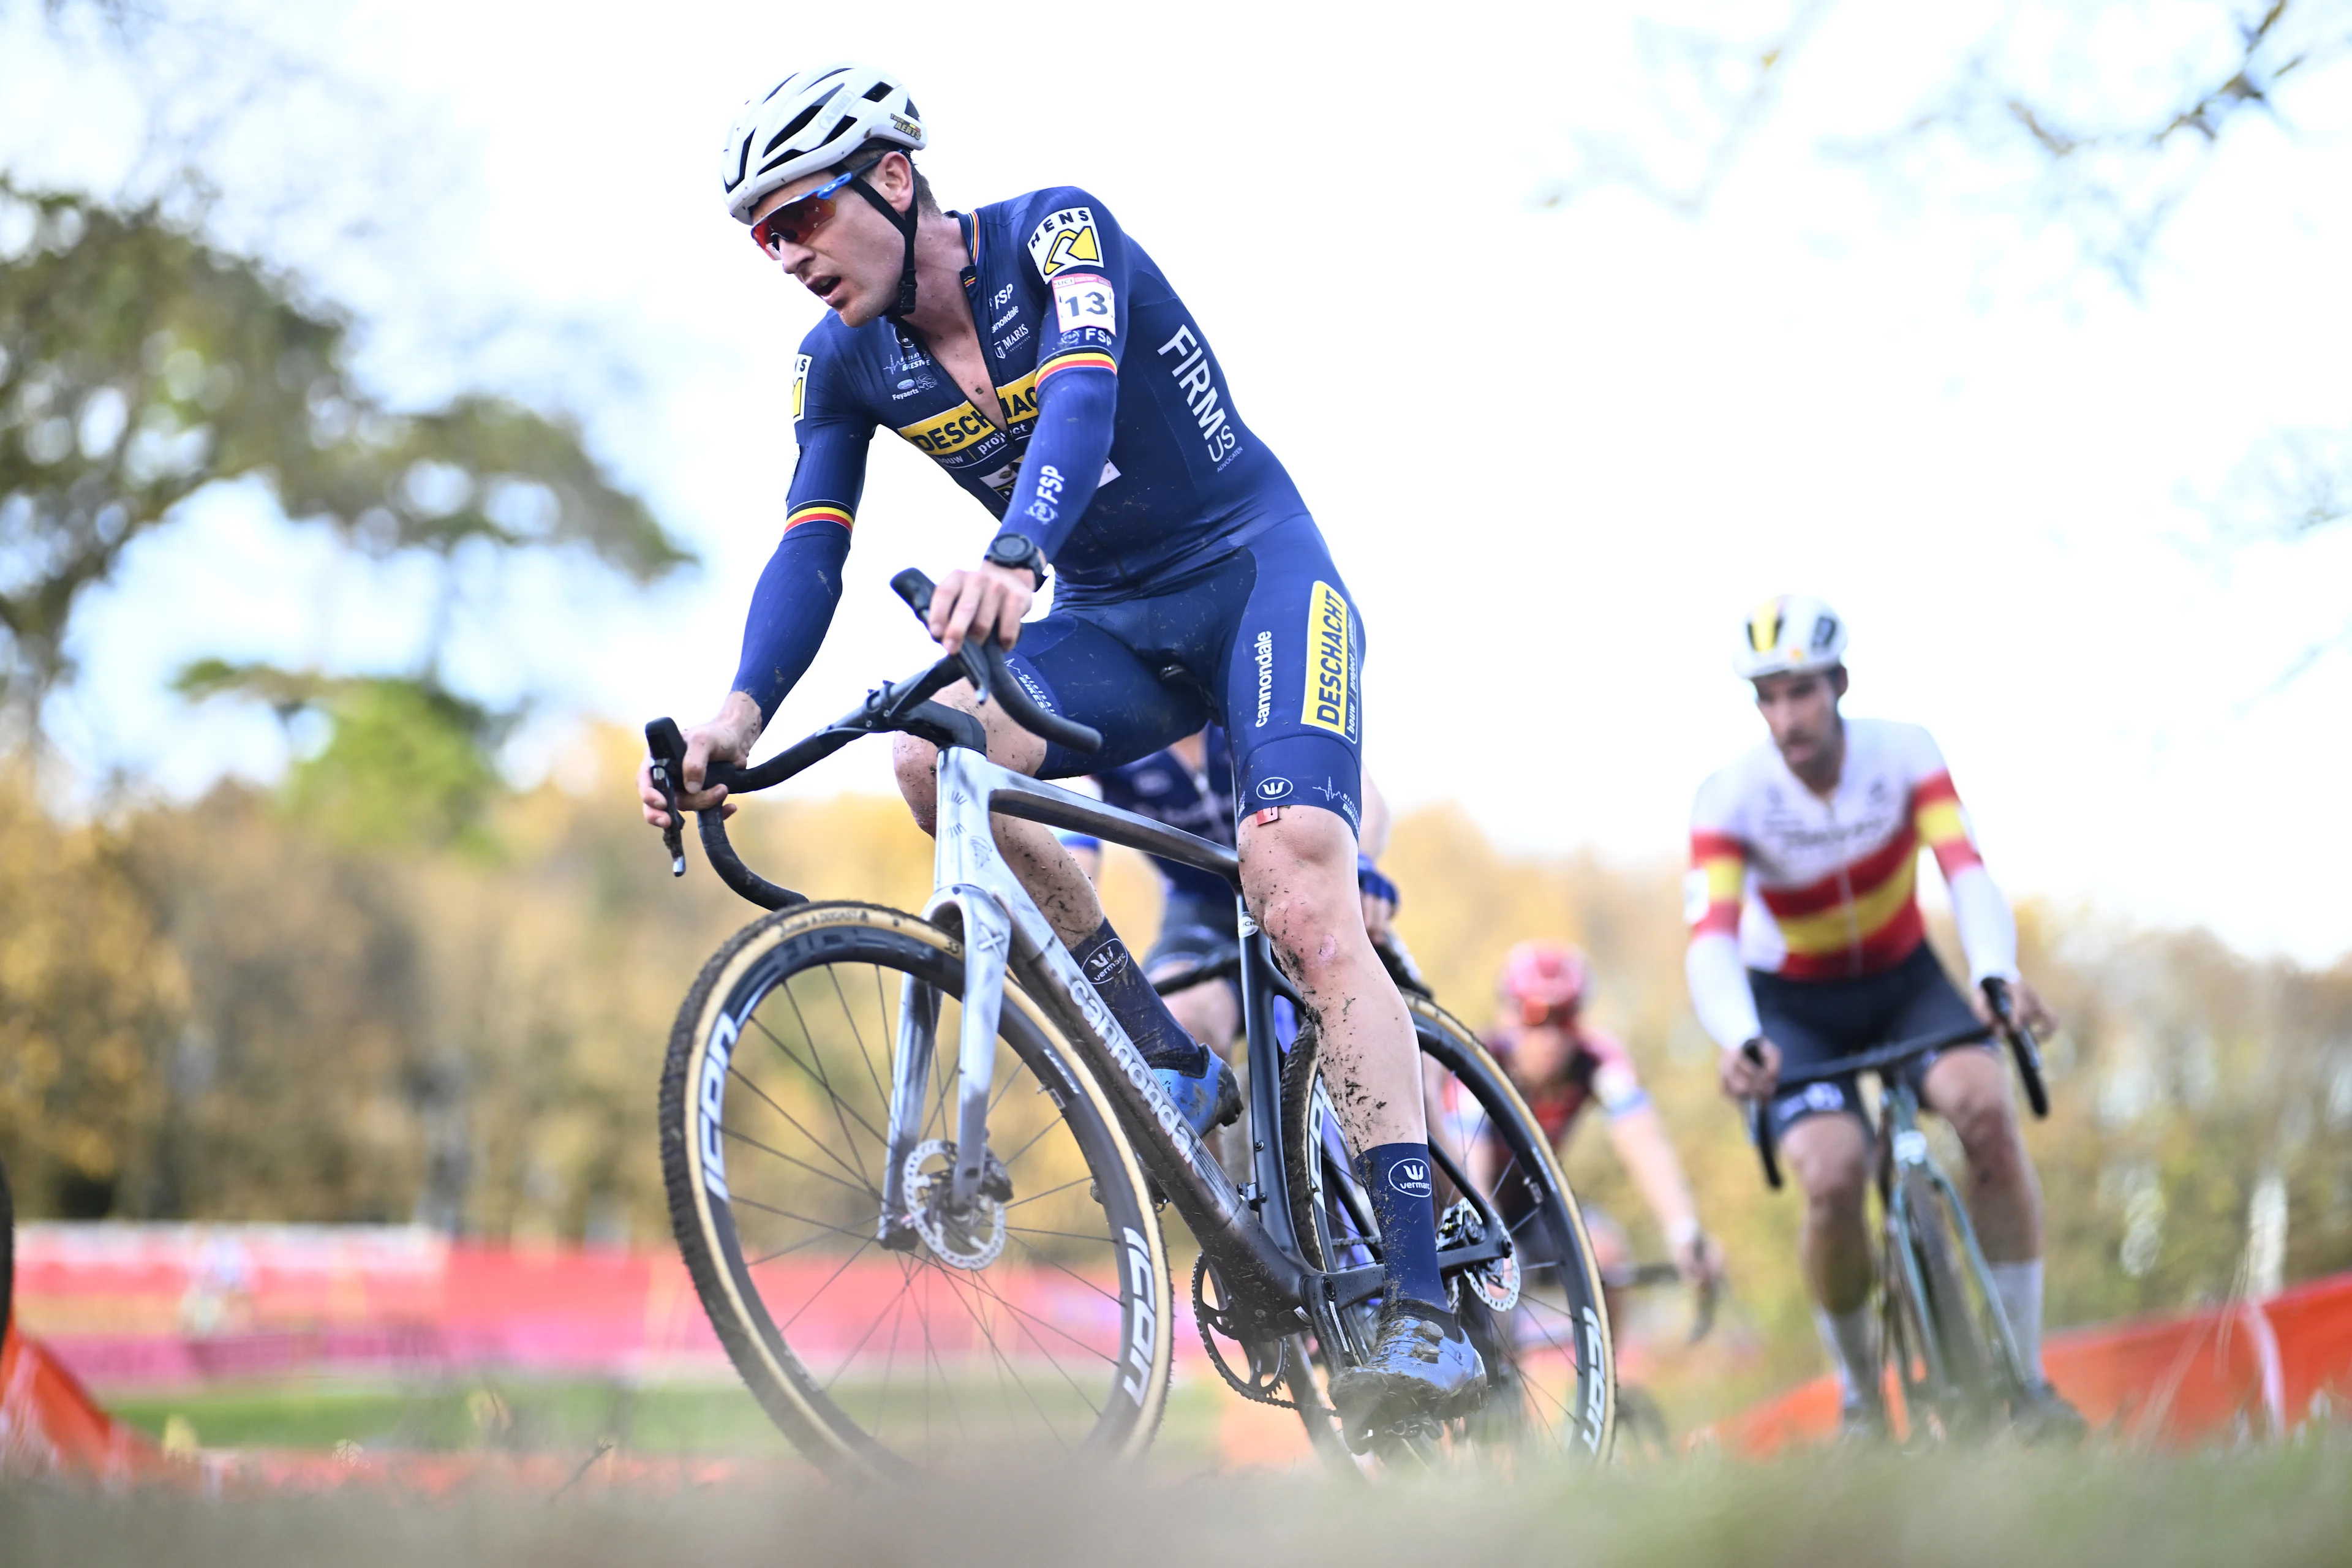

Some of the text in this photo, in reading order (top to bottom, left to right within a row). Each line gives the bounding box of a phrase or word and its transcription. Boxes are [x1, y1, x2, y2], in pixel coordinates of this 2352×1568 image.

[894, 121, 921, 140] AERTS
[1031, 210, 1089, 249] HENS
[994, 284, 1014, 309] FSP
[1065, 291, 1108, 317] 13
[1001, 323, 1029, 350] MARIS
[1085, 328, 1112, 346] FSP
[892, 388, 919, 401] Feyaerts
[1217, 446, 1243, 473] ADVOCATEN
[1036, 465, 1065, 505] FSP
[1316, 589, 1343, 726] DESCHACHT
[1254, 631, 1273, 728] cannondale
[1346, 702, 1356, 734] bouw
[1093, 952, 1126, 981] vermarc
